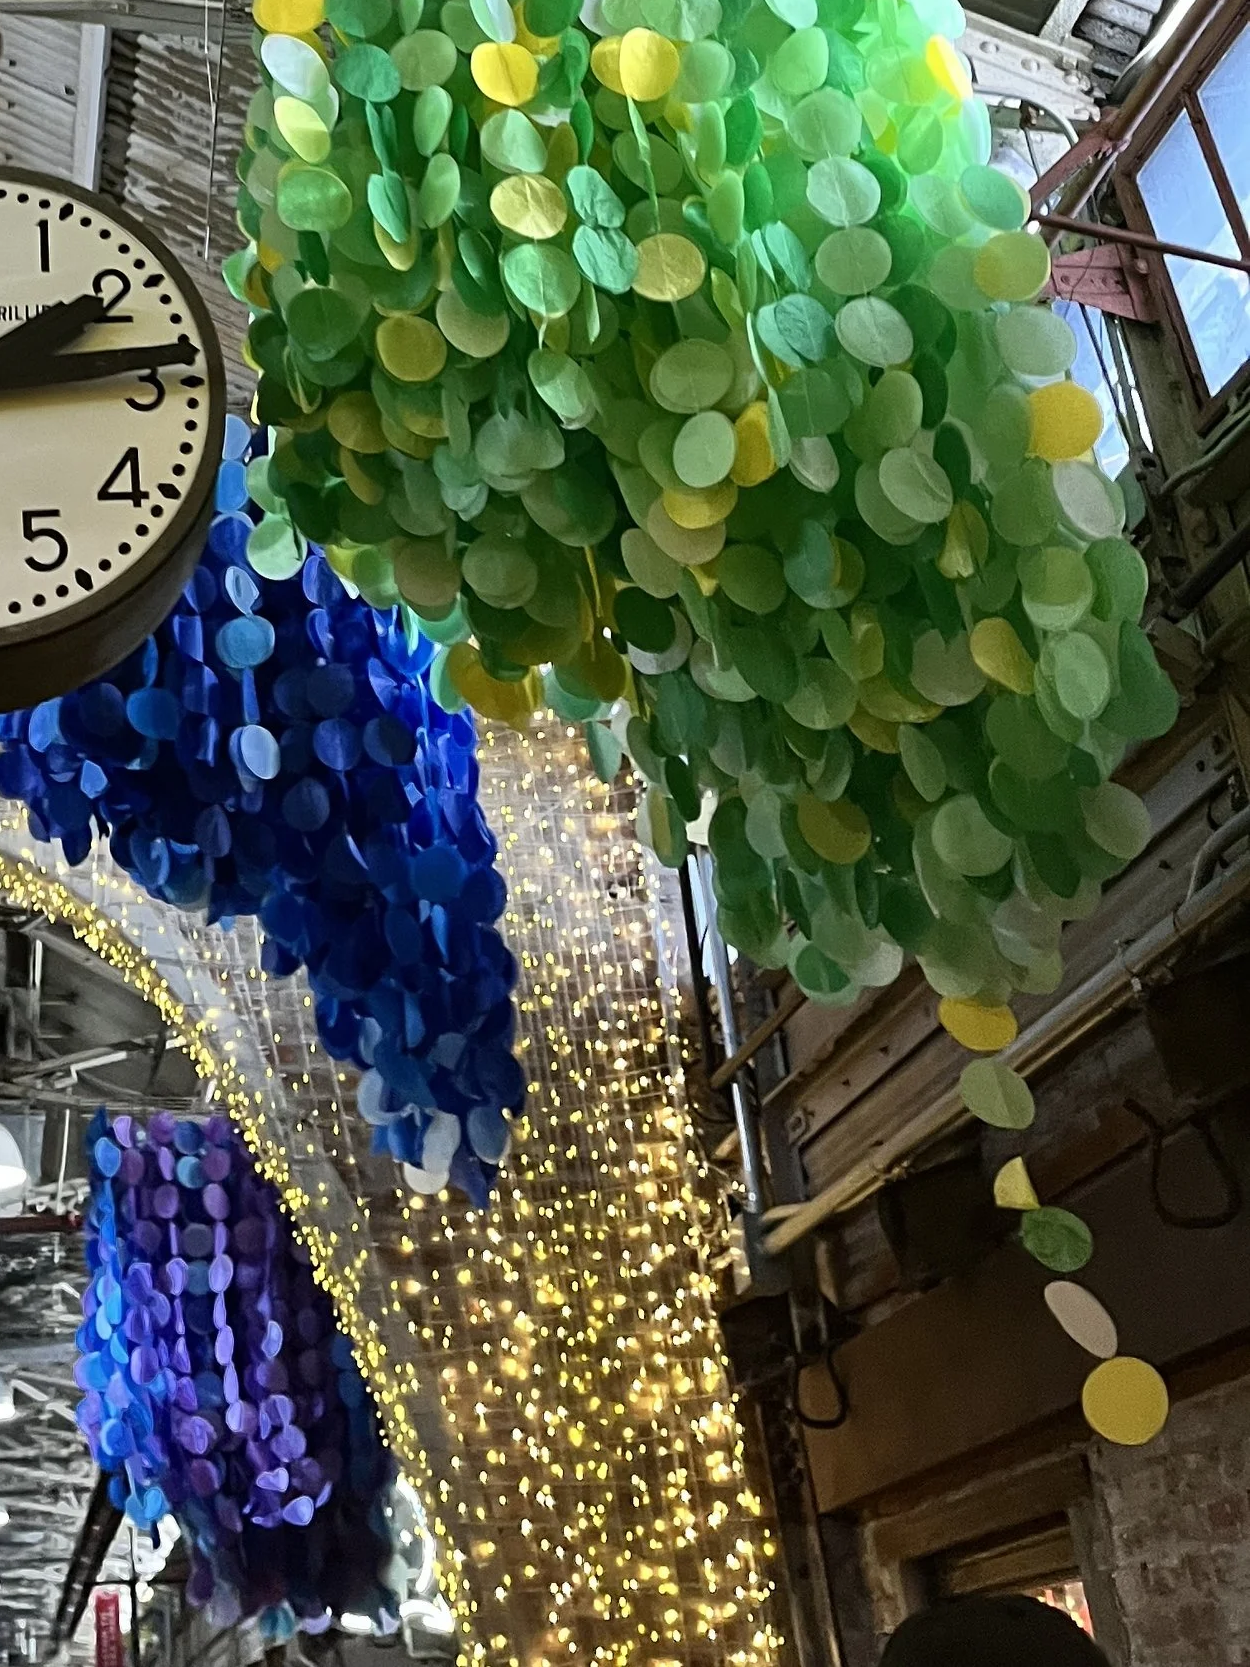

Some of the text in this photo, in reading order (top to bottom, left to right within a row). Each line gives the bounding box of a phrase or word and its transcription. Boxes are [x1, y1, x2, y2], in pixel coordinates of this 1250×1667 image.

[36, 219, 50, 272] 1
[93, 269, 134, 323] 2
[96, 447, 150, 508] 4
[21, 509, 69, 573] 5
